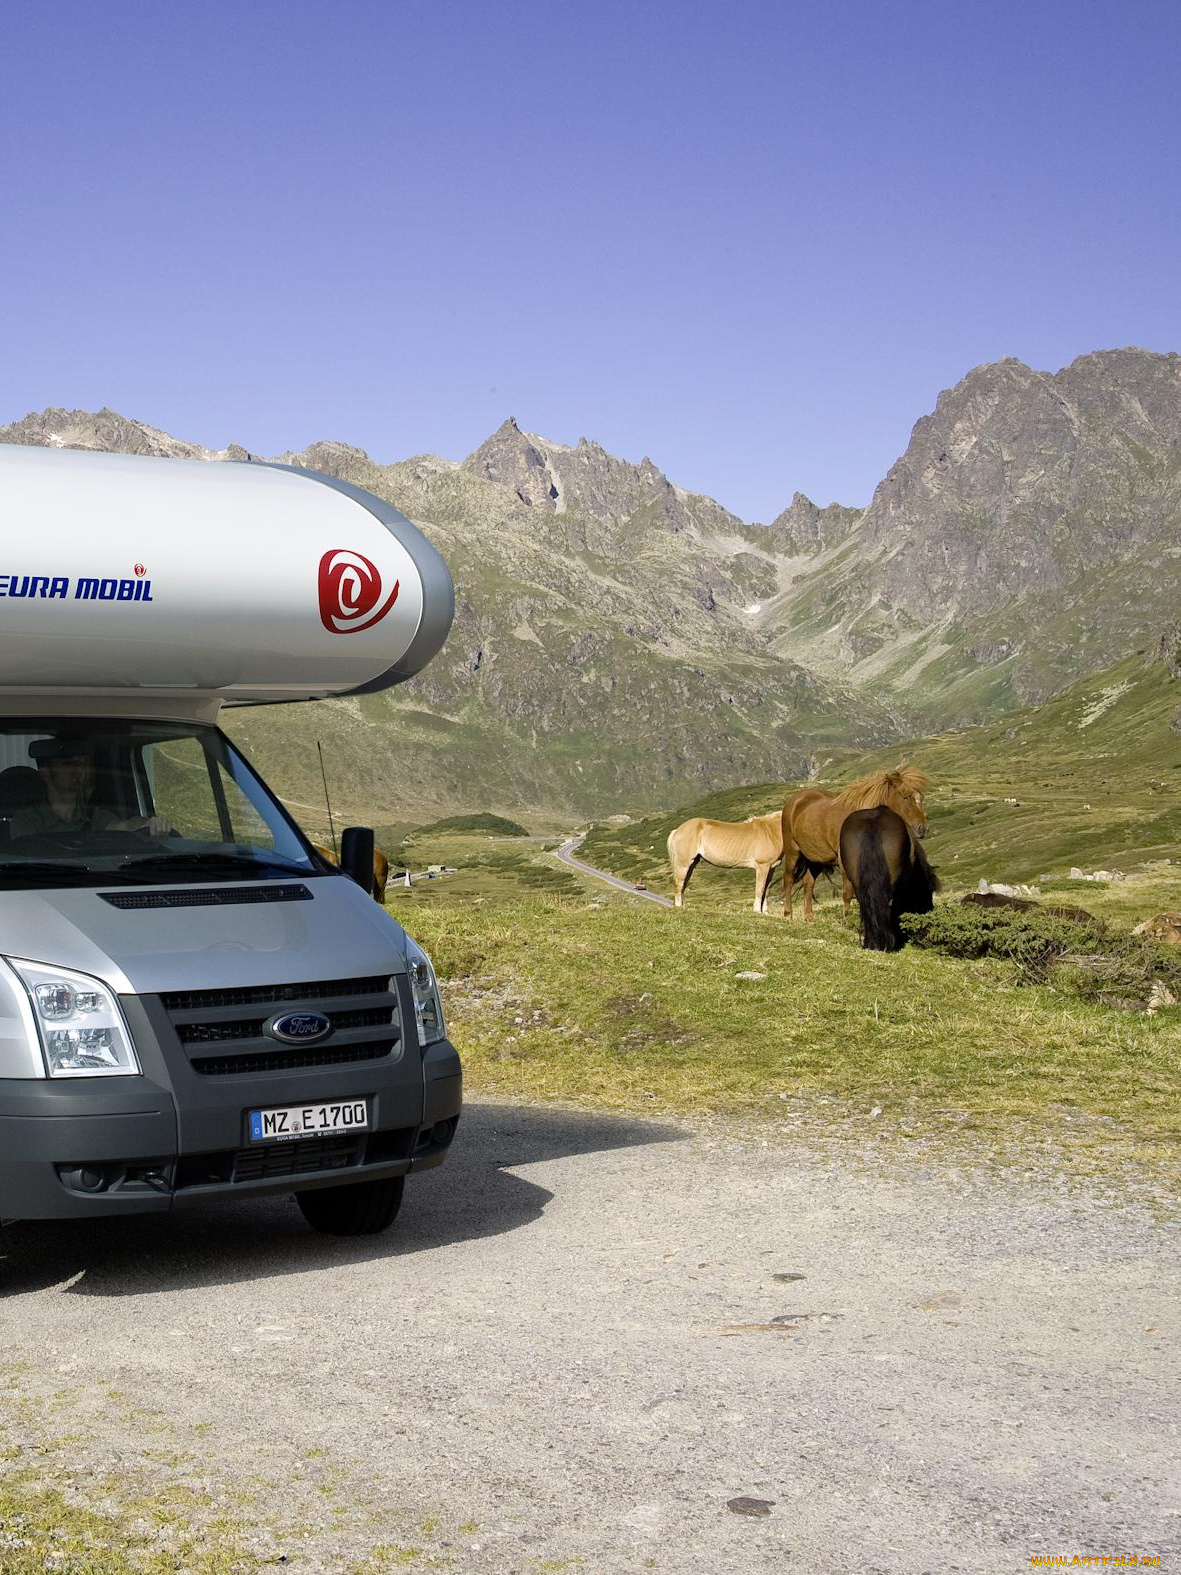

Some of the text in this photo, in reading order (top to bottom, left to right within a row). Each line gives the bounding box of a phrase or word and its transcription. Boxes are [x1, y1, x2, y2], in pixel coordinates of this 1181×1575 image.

[74, 578, 153, 602] MOBIL
[289, 1016, 320, 1035] Ford
[263, 1103, 365, 1135] MZ E 1700
